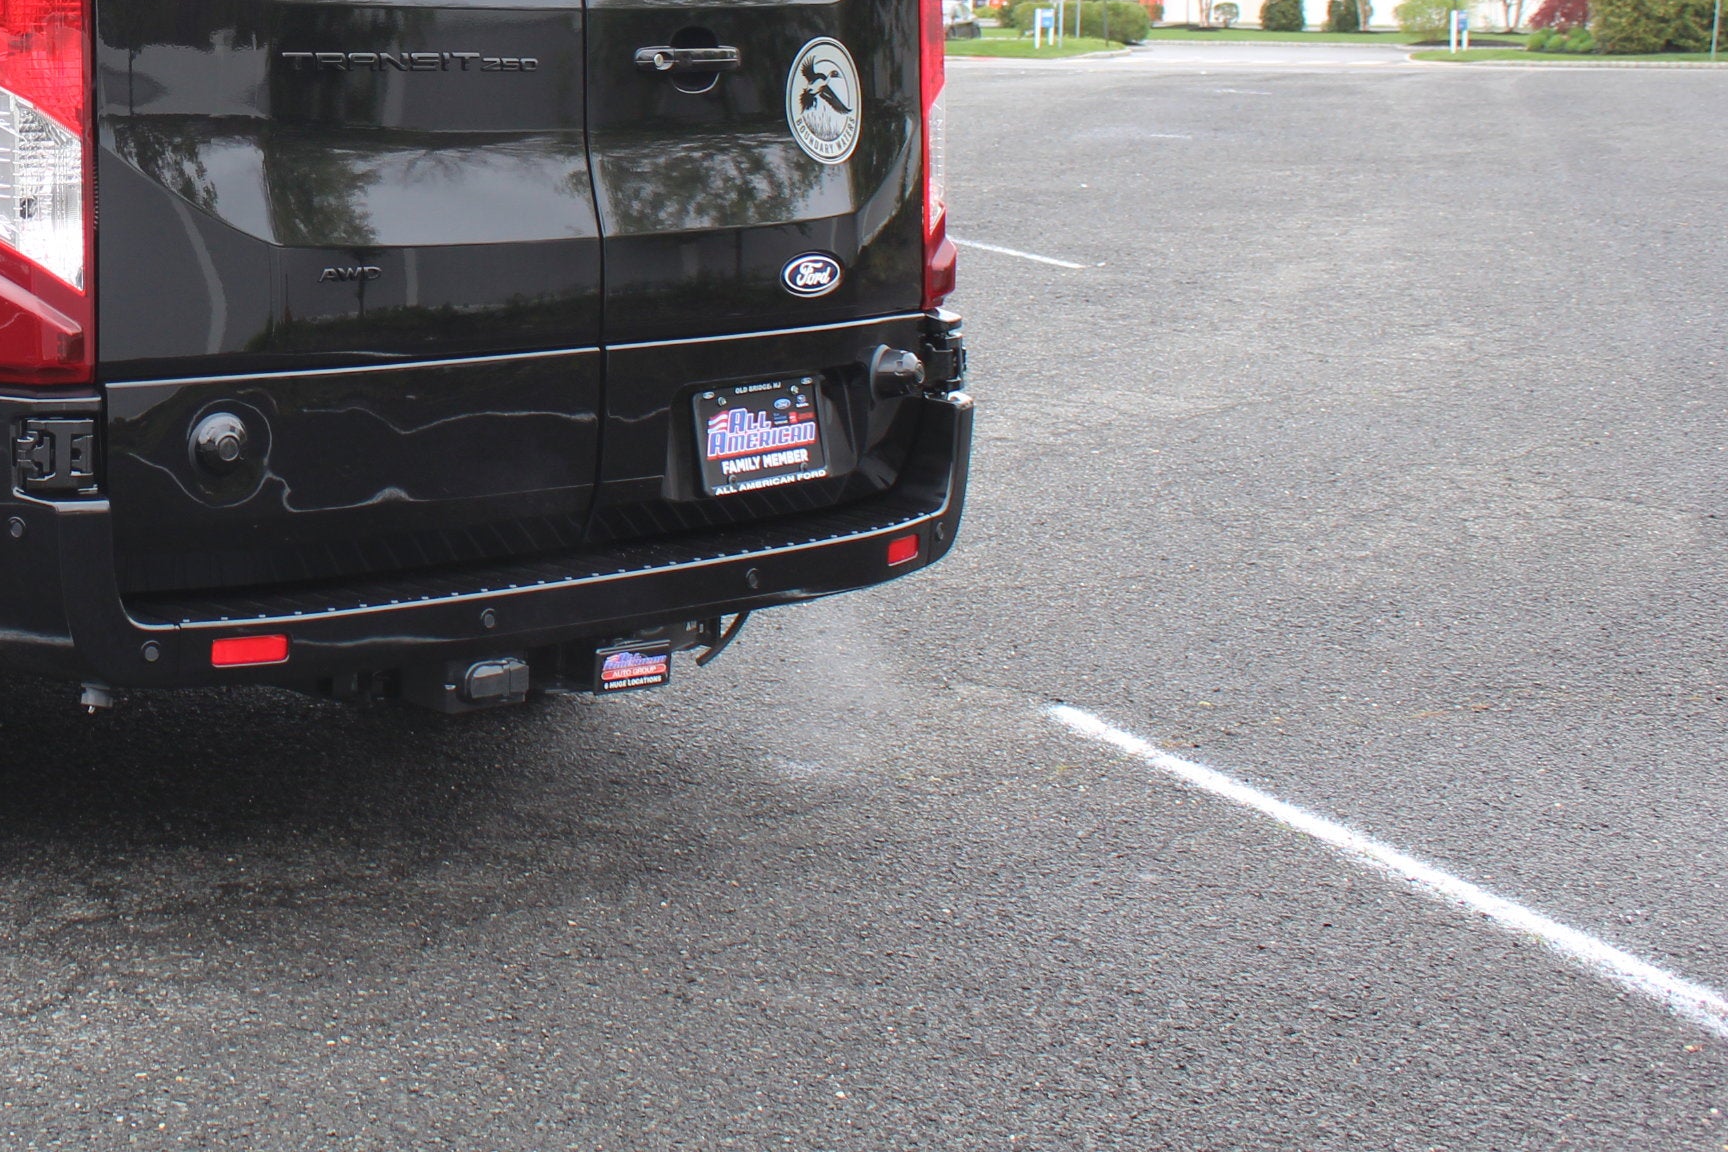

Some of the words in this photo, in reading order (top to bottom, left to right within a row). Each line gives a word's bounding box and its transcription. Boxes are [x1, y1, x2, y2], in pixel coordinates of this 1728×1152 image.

[282, 51, 481, 72] TRANSIT
[480, 56, 539, 72] 250
[795, 117, 834, 154] BOUNDARY
[317, 266, 382, 283] AWD
[796, 261, 831, 286] Ford
[735, 386, 748, 394] OLD
[727, 408, 772, 435] ALL
[707, 421, 815, 457] AMERICAN
[721, 455, 762, 475] FAMILY
[762, 448, 809, 468] MEMBER
[715, 485, 738, 496] ALL
[739, 475, 796, 492] AMERICAN
[797, 469, 827, 481] FORD
[612, 668, 632, 678] AUTO
[632, 664, 657, 676] GROUP
[627, 675, 662, 686] LOCATIONS
